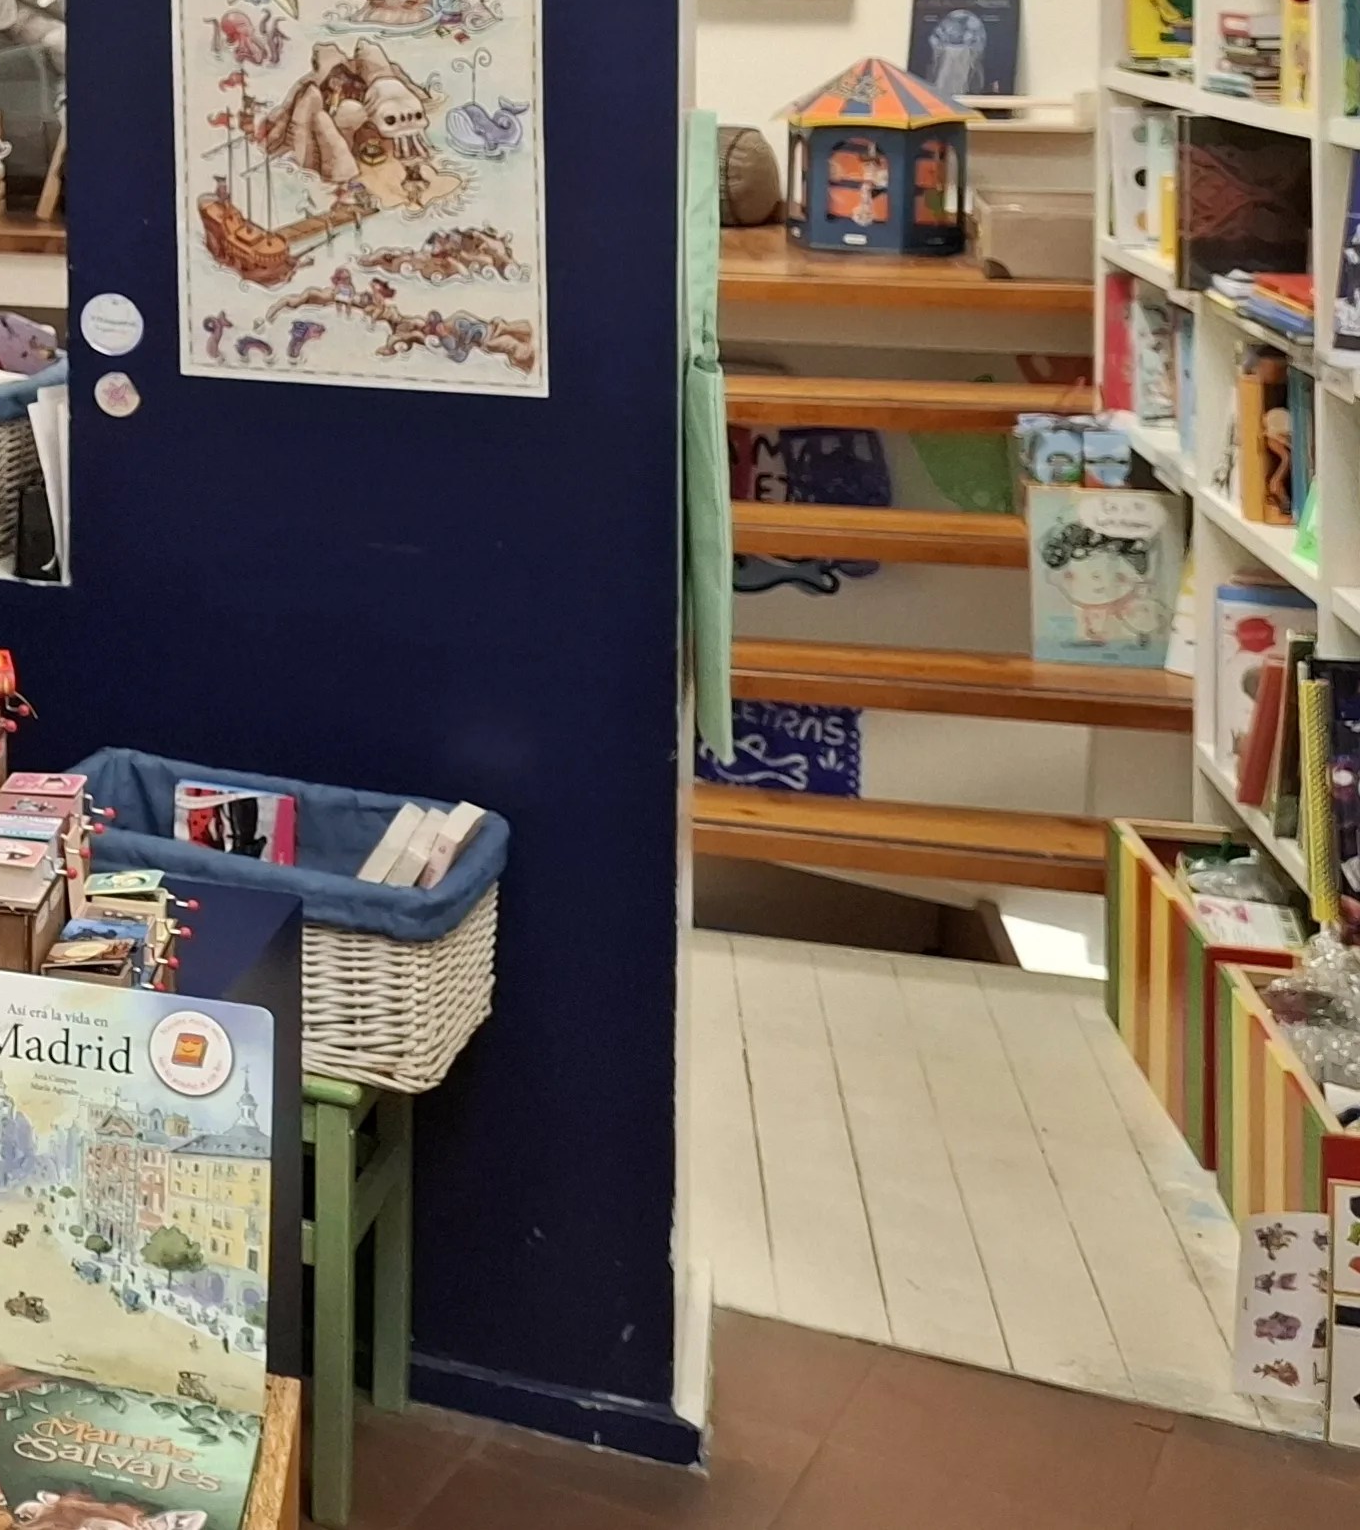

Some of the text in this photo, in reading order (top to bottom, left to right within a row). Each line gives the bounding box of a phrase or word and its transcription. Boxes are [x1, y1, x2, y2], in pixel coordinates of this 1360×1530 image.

[6, 1002, 109, 1028] Así era la vida en
[12, 1431, 222, 1492] Salvajes
[32, 1415, 197, 1463] Mamás
